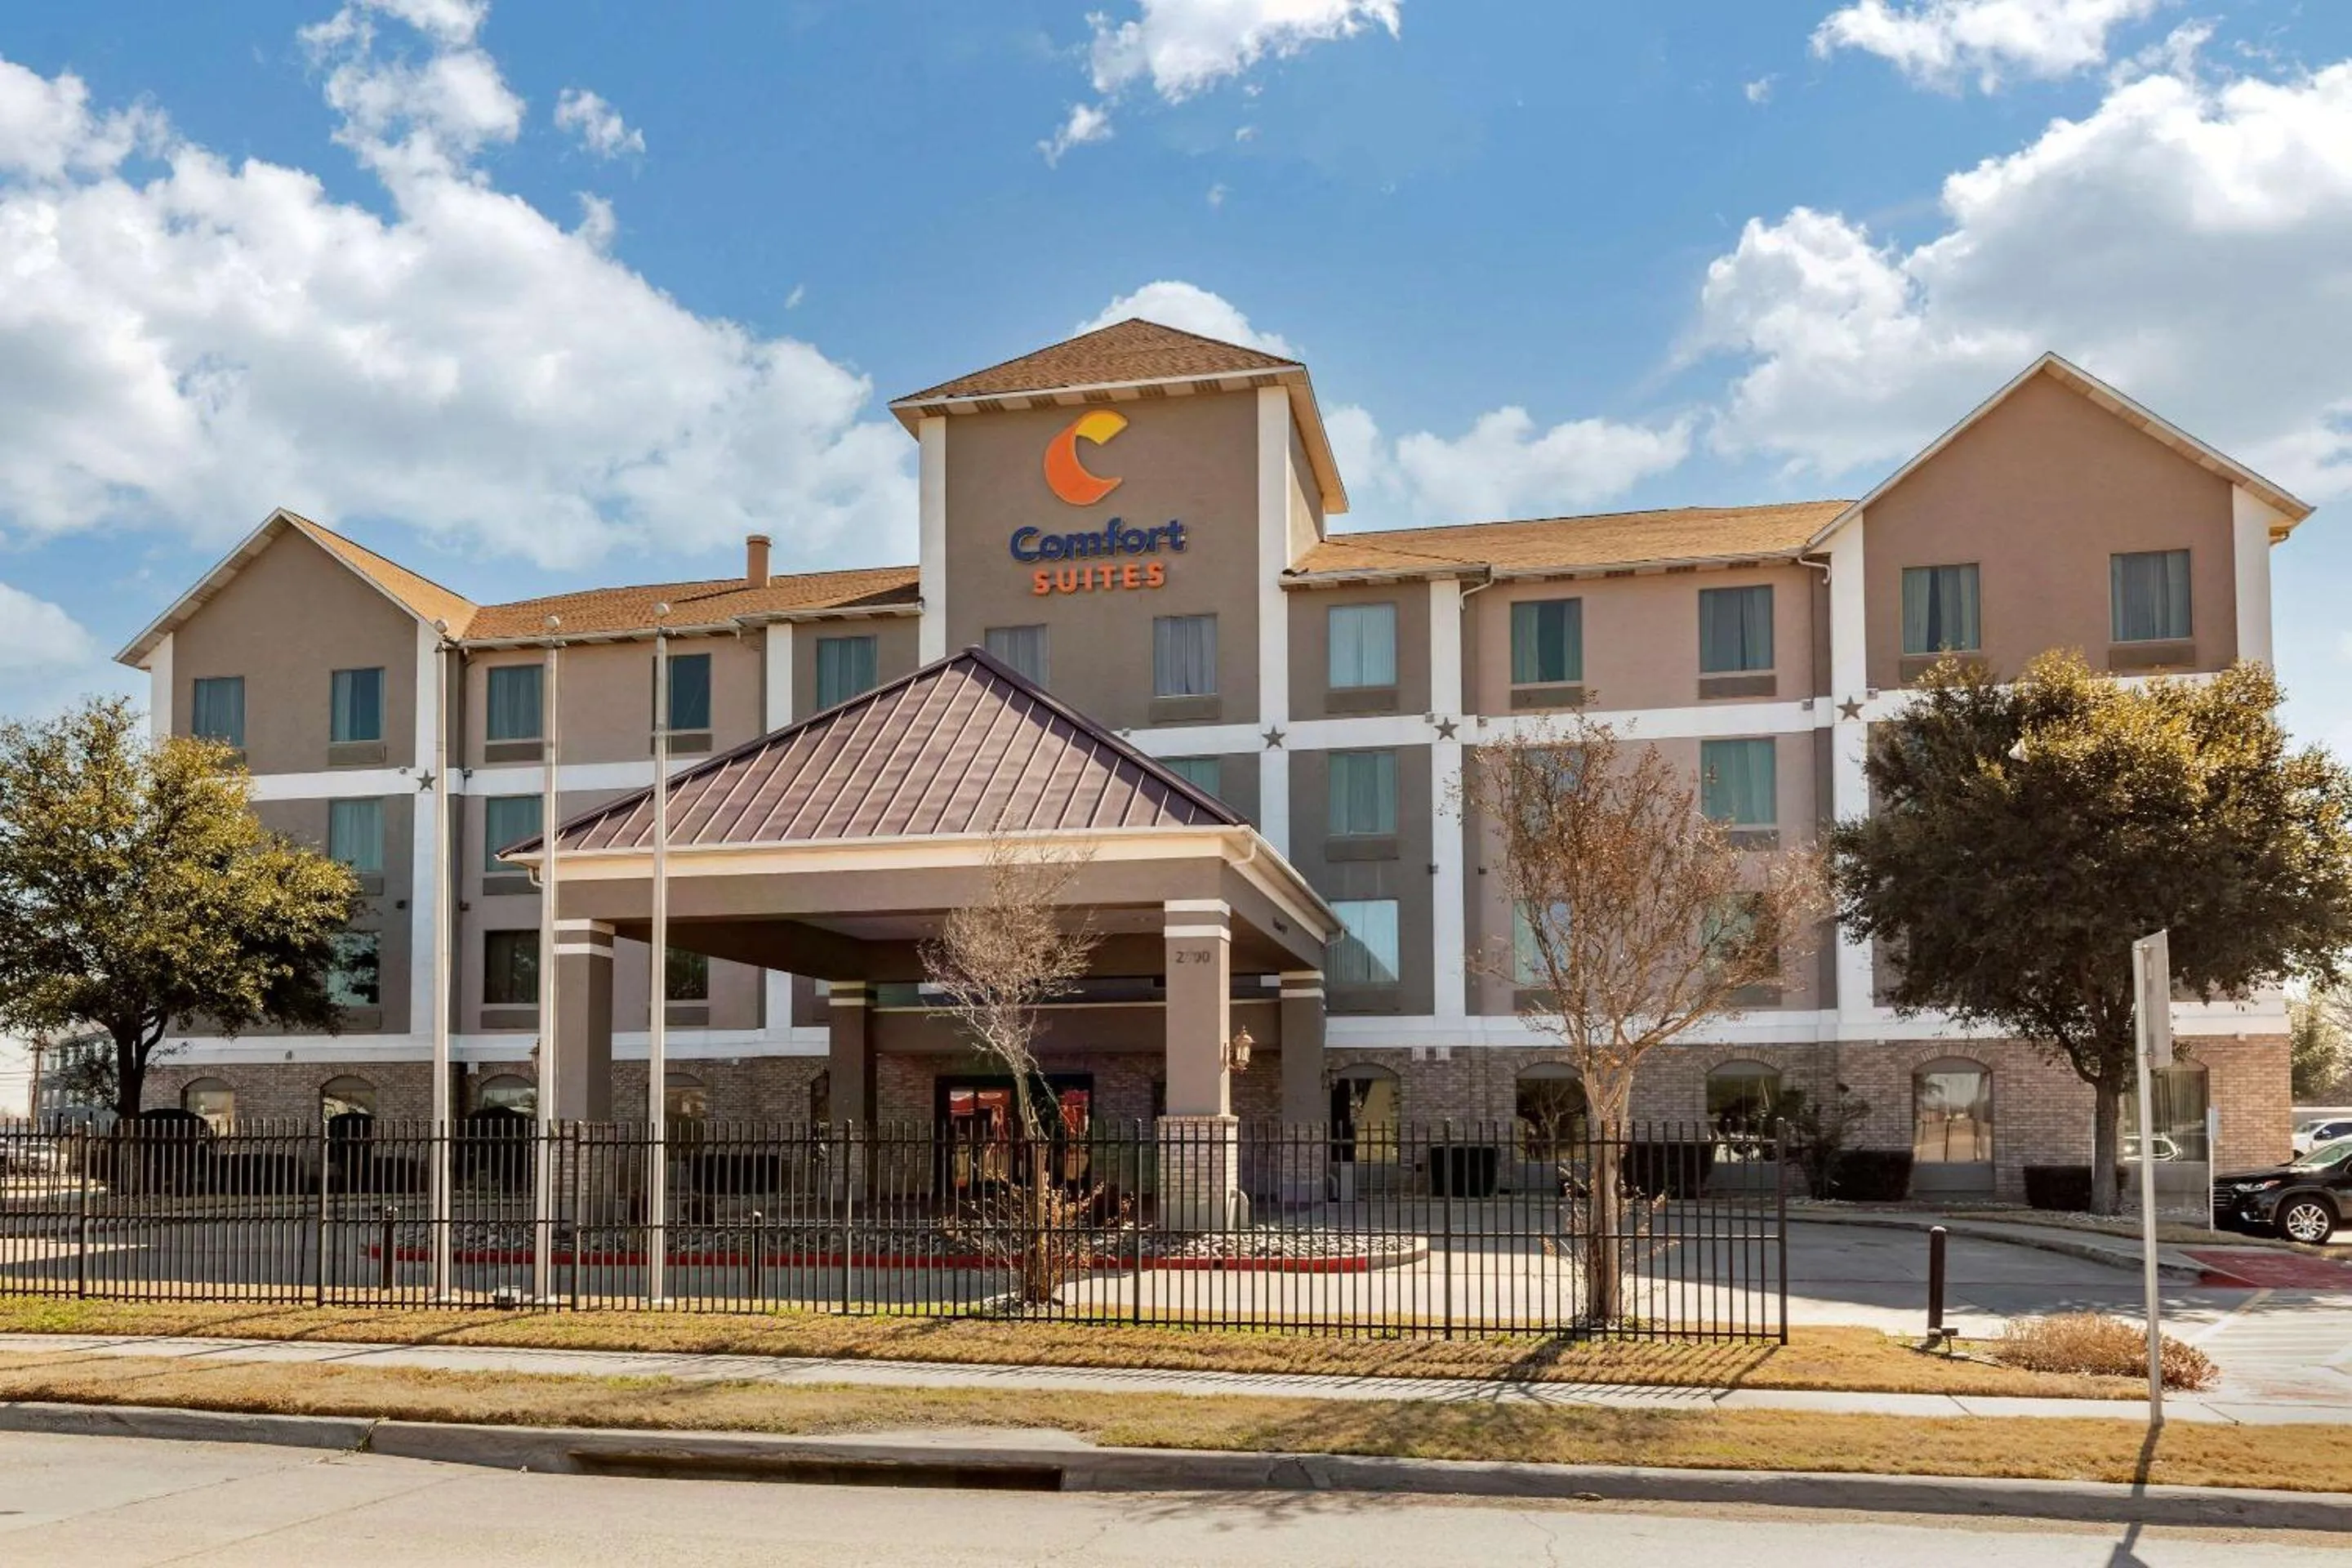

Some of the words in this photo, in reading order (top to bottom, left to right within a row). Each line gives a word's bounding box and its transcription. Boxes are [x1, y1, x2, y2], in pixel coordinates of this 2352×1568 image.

[1010, 517, 1187, 562] Comfort
[1032, 561, 1165, 595] SUITES
[1176, 951, 1210, 964] 200
